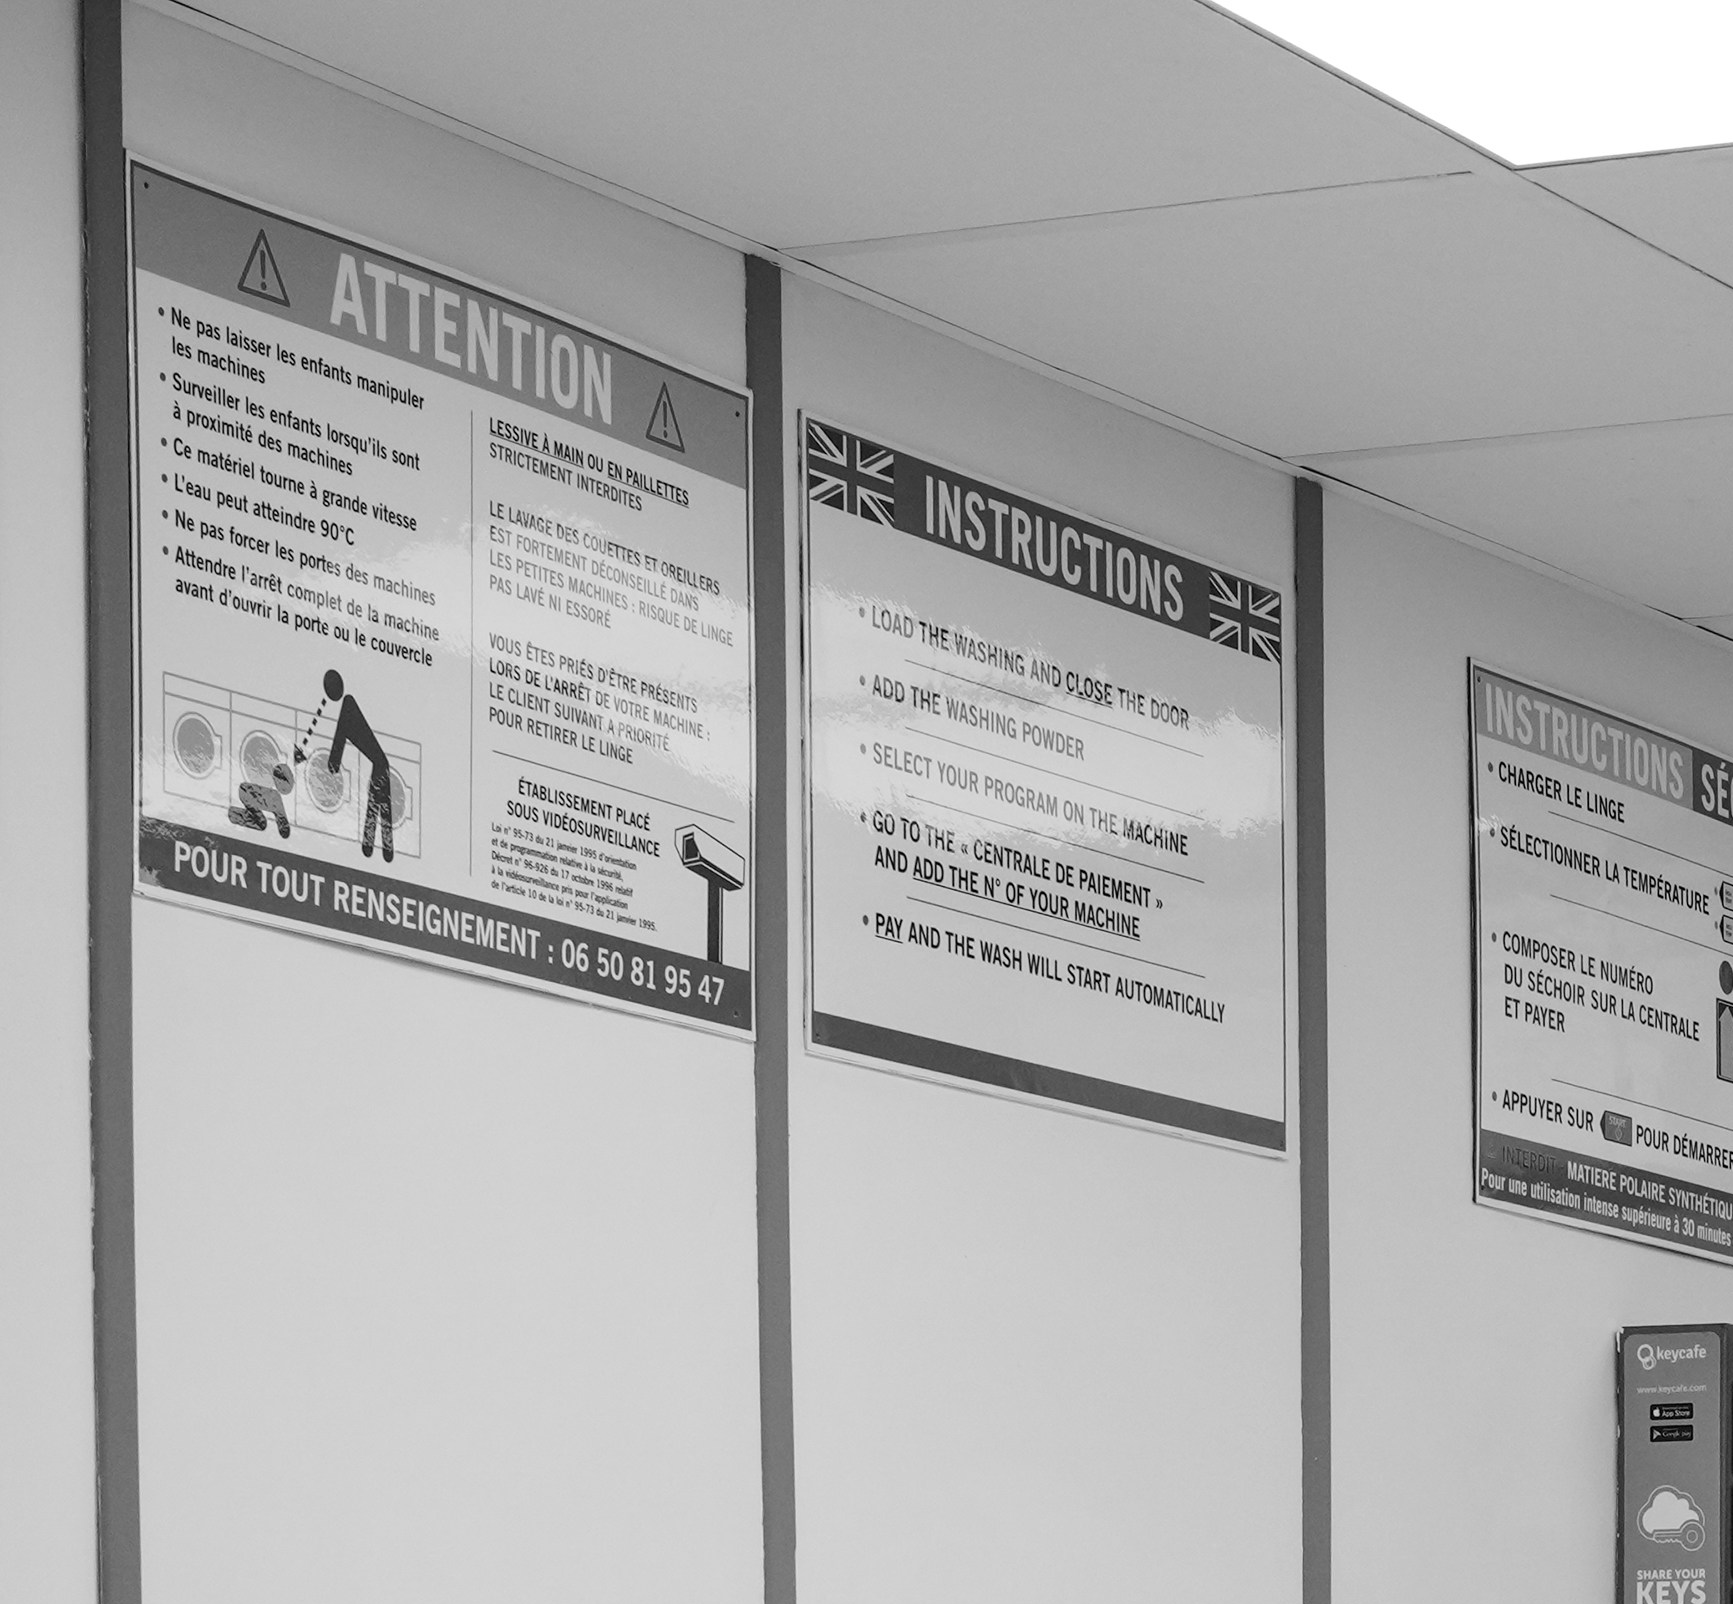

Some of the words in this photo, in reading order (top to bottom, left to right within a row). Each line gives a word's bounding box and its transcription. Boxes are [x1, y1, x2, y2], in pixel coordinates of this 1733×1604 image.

[171, 306, 191, 330] Ne
[196, 320, 221, 341] pas
[226, 326, 271, 357] laisser
[276, 343, 296, 366] les
[301, 356, 352, 385] enfants
[357, 375, 424, 410] manipuler
[330, 253, 612, 425] ATTENTION
[489, 416, 539, 450] LESSIVE
[542, 432, 551, 454] À
[554, 440, 585, 467] MAIN
[588, 453, 604, 474] OU
[607, 460, 623, 481] EN
[626, 468, 690, 507] PAILLETTES
[489, 442, 572, 485] STRICTEMENT
[577, 473, 642, 511] INTERDITES
[926, 475, 1184, 621] INSTRUCTIONS
[872, 605, 913, 638] LOAD
[918, 620, 949, 651] THE
[954, 632, 1024, 676] WASHING
[1030, 659, 1061, 687] AND
[1066, 671, 1112, 705] CLOSE
[1117, 687, 1145, 716] THE
[1151, 698, 1189, 730] DOOR
[1485, 682, 1684, 799] INSTRUCTIONS
[518, 779, 612, 819] ÉTABLISSEMENT
[616, 807, 650, 831] PLACÉ
[1498, 761, 1562, 802] CHARGER
[1566, 784, 1582, 809] LE
[1586, 791, 1625, 823] LINGE
[507, 800, 539, 823] SOUS
[542, 810, 660, 857] VIDÉOSURVEILLANCE
[174, 840, 247, 889] POUR
[256, 860, 325, 906] TOUT
[334, 880, 541, 959] RENSEIGNEMENT
[561, 938, 589, 972] 06
[597, 947, 624, 981] 50
[630, 956, 656, 990] 81
[664, 965, 691, 998] 95
[698, 974, 724, 1005] 47
[875, 912, 903, 939] PAY
[908, 921, 940, 949] AND
[945, 930, 975, 959] THE
[980, 940, 1022, 971] WASH
[1027, 952, 1062, 982] WILL
[1067, 963, 1111, 993] START
[1115, 976, 1225, 1023] AUTOMATICALLY
[1502, 930, 1576, 972] COMPOSER
[1580, 954, 1596, 978] LE
[1600, 960, 1653, 995] NUMÉRO
[1502, 1089, 1562, 1124] APPUYER
[1567, 1106, 1593, 1132] SUR
[1636, 1124, 1669, 1152] POUR
[1502, 1146, 1557, 1173] INTERDIT
[1567, 1160, 1616, 1191] MATIERE
[1620, 1174, 1666, 1203] POLAIRE
[1656, 1344, 1707, 1364] keycafe
[1637, 1568, 1672, 1580] SHARE
[1674, 1568, 1706, 1580] YOUR
